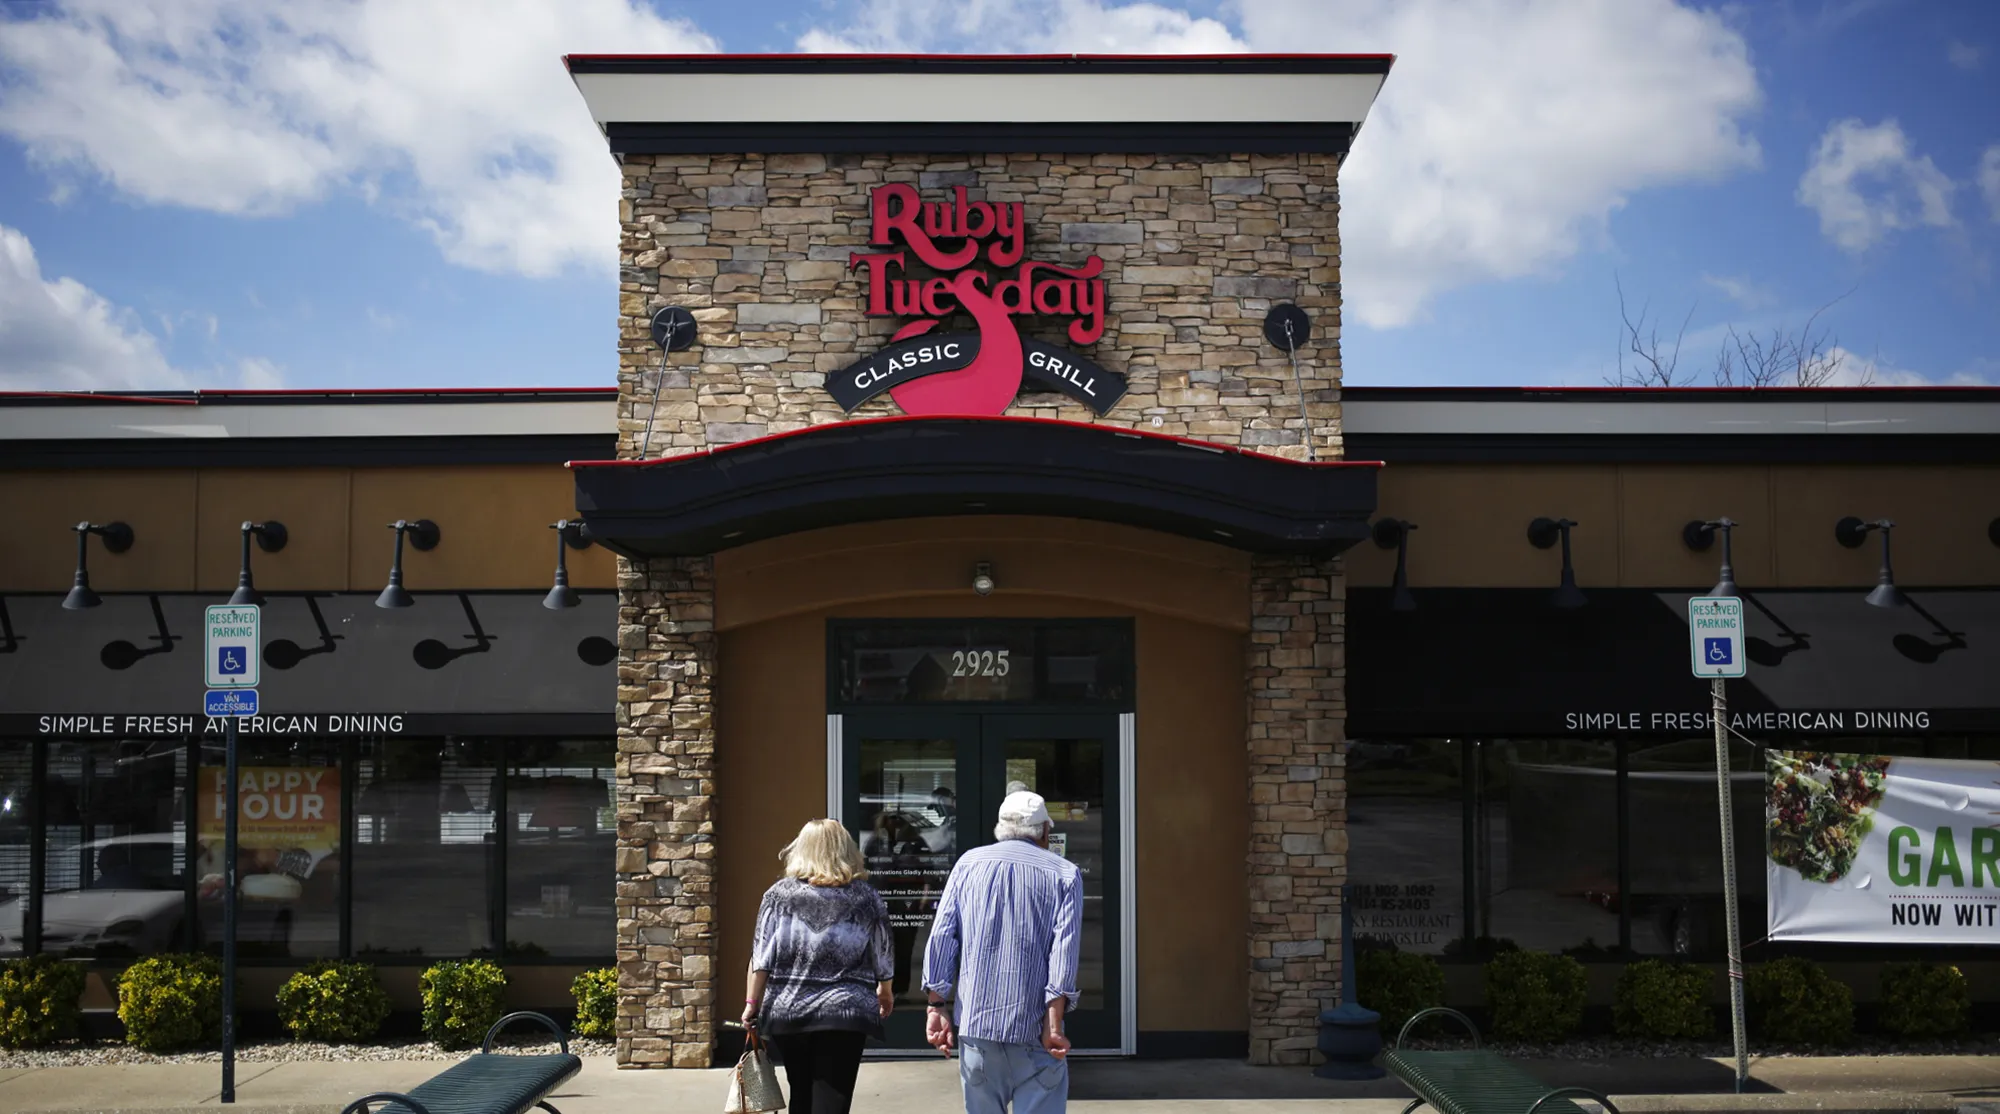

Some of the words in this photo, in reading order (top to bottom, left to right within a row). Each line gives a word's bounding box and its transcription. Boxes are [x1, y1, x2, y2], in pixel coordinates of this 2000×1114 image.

[868, 183, 1025, 270] Ruby
[850, 251, 1105, 416] Tuesday
[854, 343, 960, 390] CLASSIC
[1029, 351, 1097, 397] GRILL
[209, 613, 256, 624] RESERVED
[1693, 605, 1738, 616] RESERVED
[212, 627, 252, 638] PARKING
[1697, 618, 1736, 629] PARKING
[952, 650, 1010, 677] 2925
[208, 702, 255, 713] ACCESSIBLE
[223, 694, 240, 703] VAN
[39, 716, 115, 733] SIMPLE
[125, 716, 193, 733] FRESH
[328, 715, 403, 733] DINING
[1566, 712, 1642, 730] SIMPLE
[1651, 712, 1716, 730] FRESH
[1731, 712, 1844, 730] AMERICAN
[1855, 711, 1930, 729] DINING
[1888, 825, 2000, 888] GAR
[903, 869, 921, 877] Gladly
[1372, 914, 1452, 928] RESTAURANT
[1892, 904, 1942, 925] NOW
